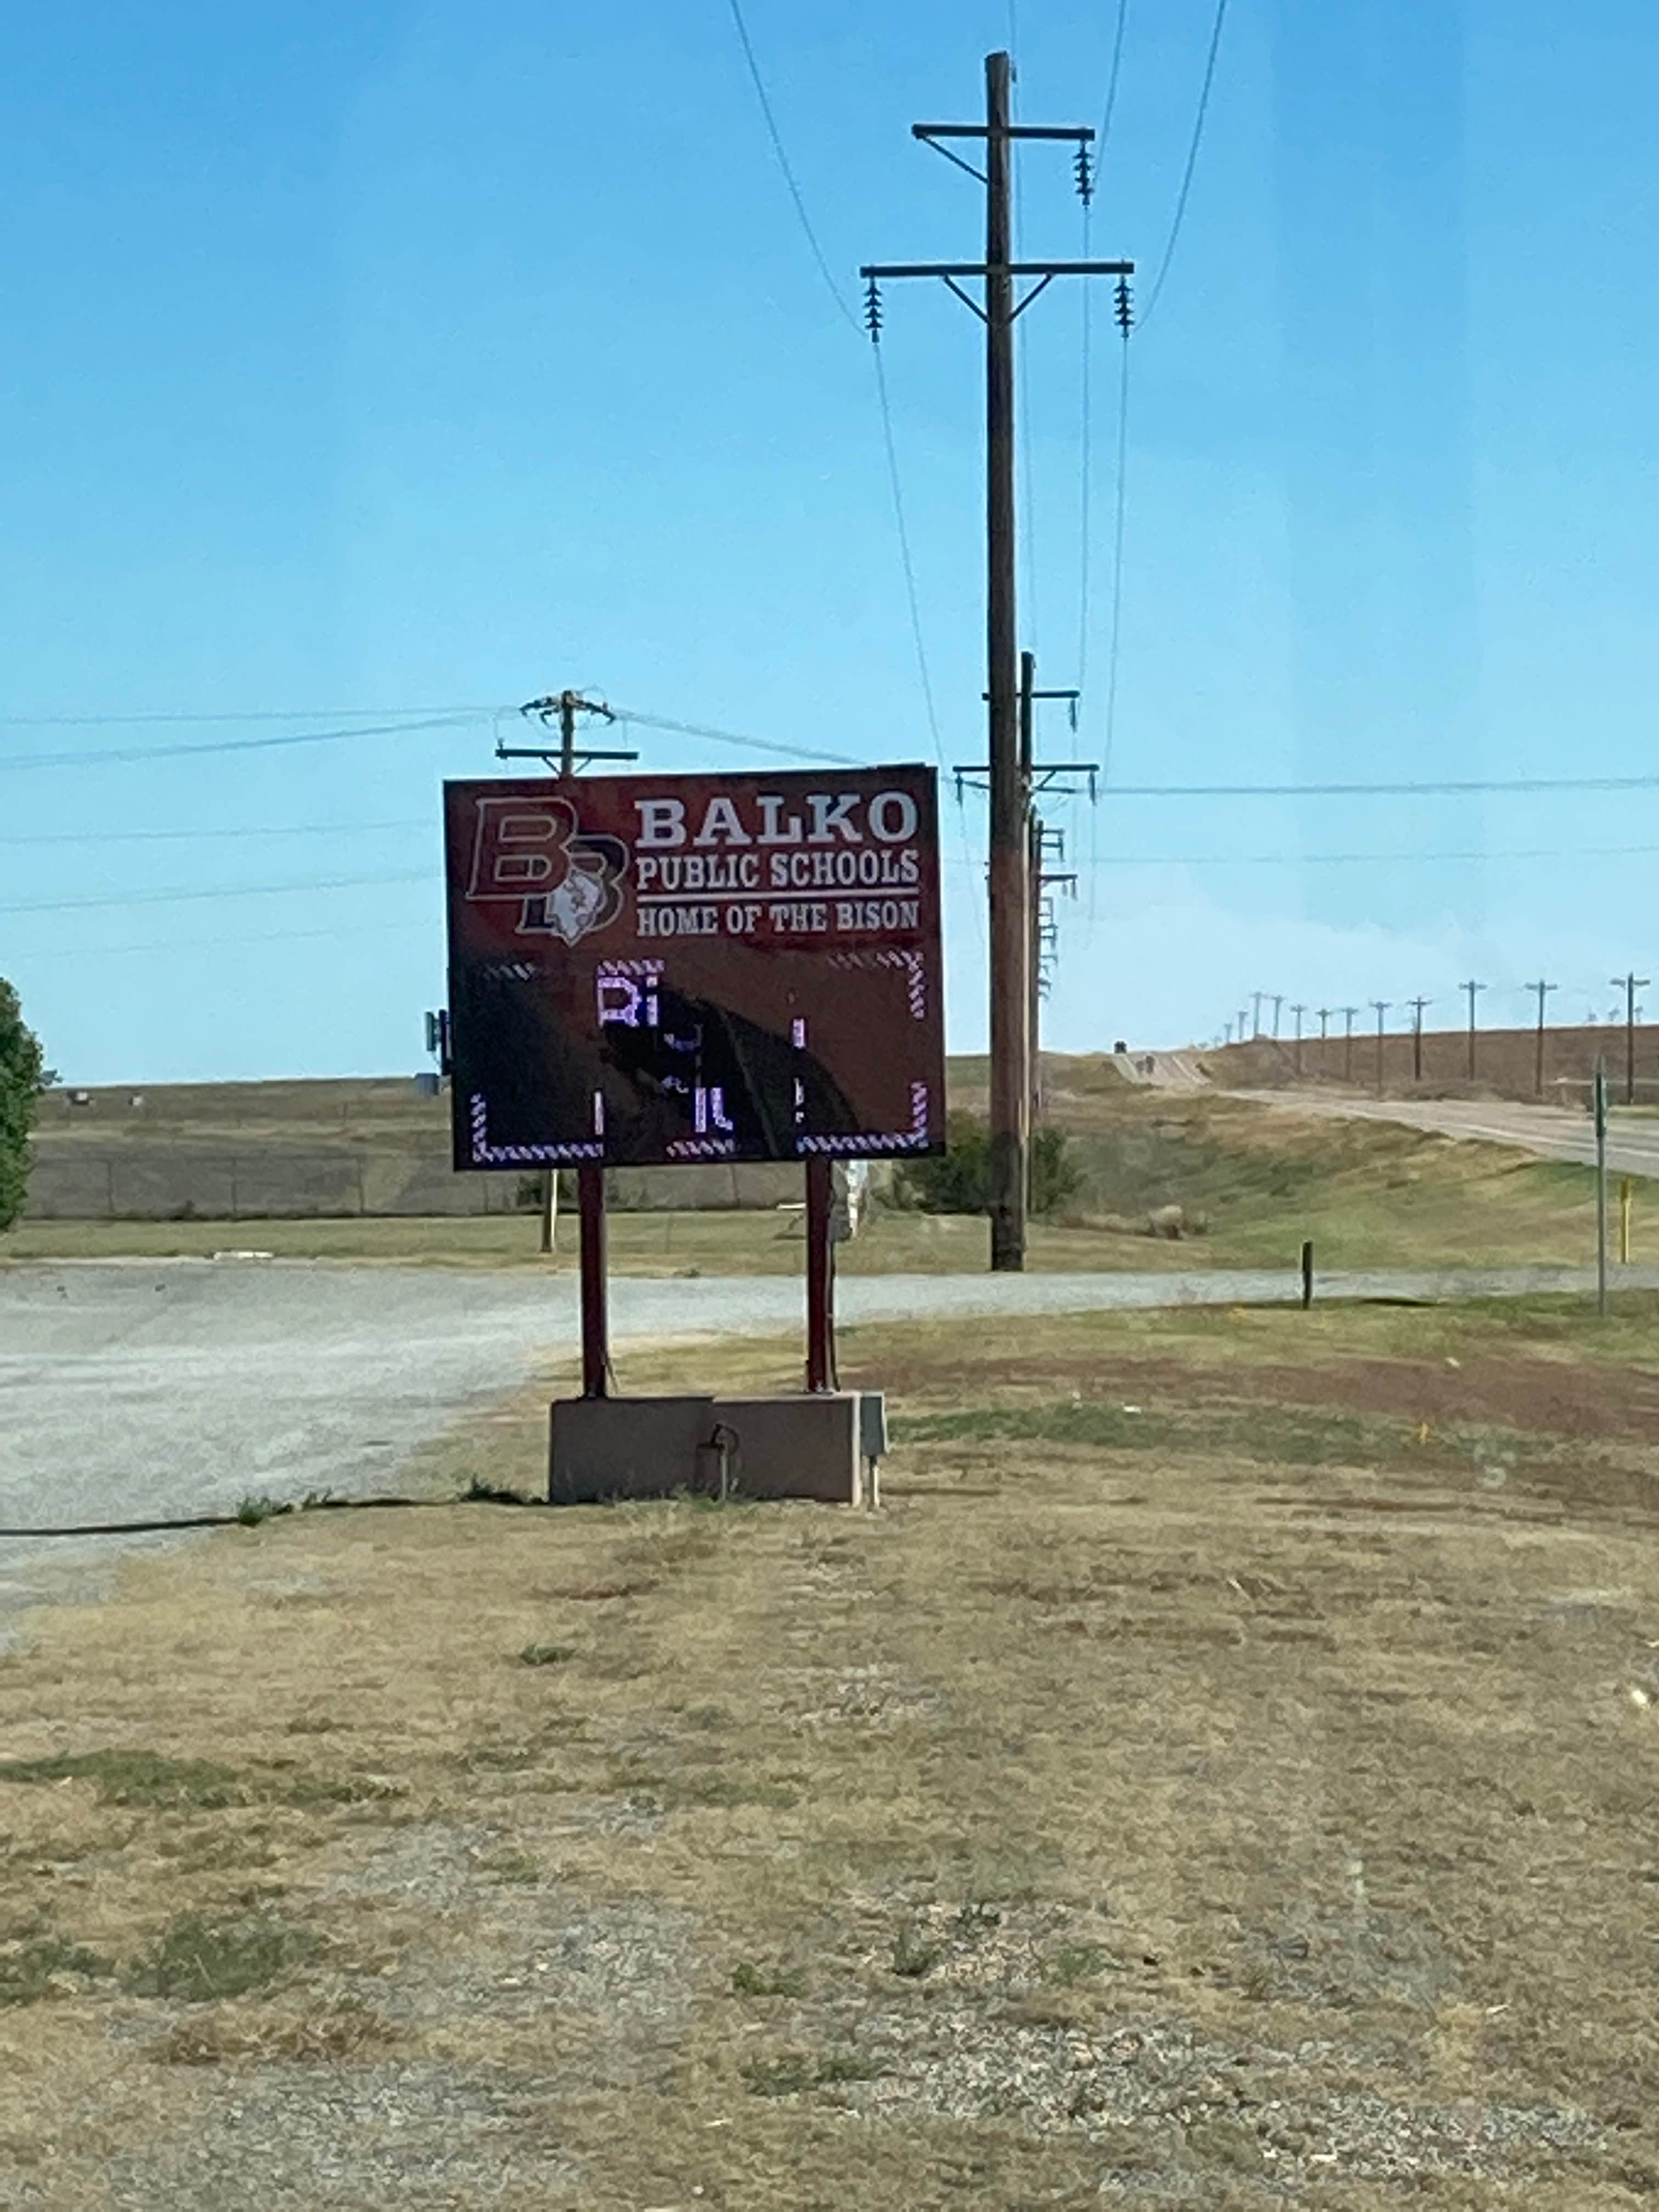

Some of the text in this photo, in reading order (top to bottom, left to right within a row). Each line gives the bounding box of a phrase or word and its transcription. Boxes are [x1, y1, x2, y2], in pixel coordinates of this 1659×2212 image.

[634, 791, 918, 849] BALKO
[636, 849, 919, 890] PUBLIC SCHOOLS
[636, 900, 919, 936] HOME OF THE BISON
